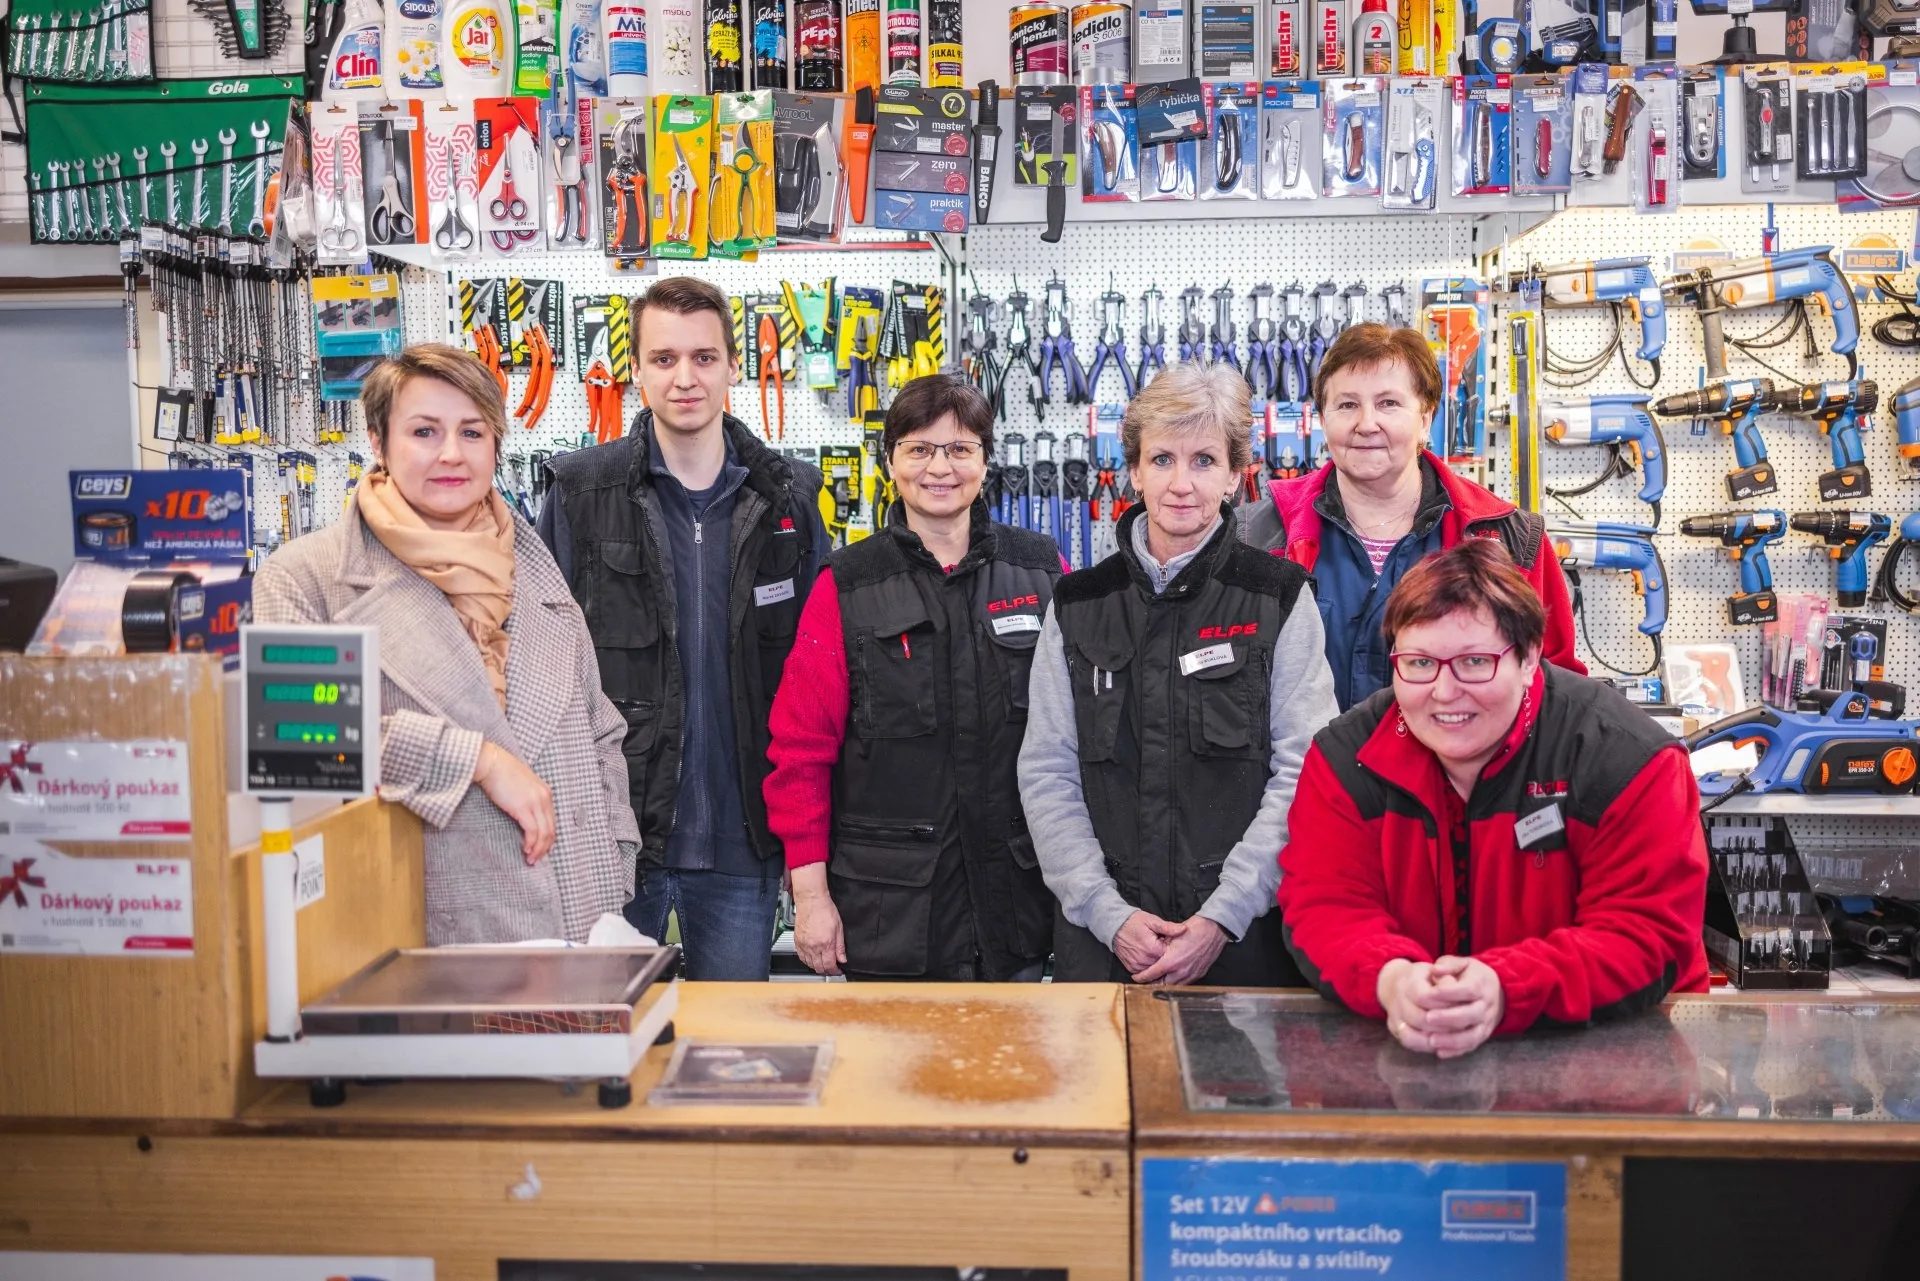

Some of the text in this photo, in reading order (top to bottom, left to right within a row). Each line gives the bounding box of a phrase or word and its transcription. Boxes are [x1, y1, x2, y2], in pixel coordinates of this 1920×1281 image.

[404, 3, 437, 14] SIDOLUX
[710, 6, 738, 25] Solvina
[756, 6, 784, 25] Solvina
[906, 18, 919, 26] DUST
[800, 26, 836, 41] PEPO
[1010, 20, 1046, 43] chnický
[1022, 27, 1057, 45] benzín
[1092, 28, 1122, 43] S 6006
[1371, 26, 1383, 39] 2
[931, 49, 955, 58] SILKAL
[336, 52, 378, 78] Clin
[1868, 71, 1884, 79] ANN
[208, 82, 249, 95] Gola
[949, 99, 955, 108] 7
[1159, 93, 1200, 108] rybička
[931, 121, 966, 132] master
[482, 123, 490, 148] orion
[931, 160, 957, 170] zero
[978, 166, 990, 209] BAHCO
[930, 199, 963, 210] praktik
[1846, 253, 1898, 268] narex
[499, 309, 506, 319] NA
[548, 311, 556, 321] NA
[577, 315, 585, 338] PLECH
[500, 323, 508, 346] PLECH
[548, 325, 556, 348] PLECH
[579, 341, 586, 352] NA
[749, 338, 756, 349] NA
[822, 457, 859, 465] STANLEY
[81, 477, 124, 494] ceys
[145, 489, 208, 520] x10
[165, 539, 212, 549] AMERICKÁ
[214, 539, 245, 549] PÁSKA
[987, 595, 1039, 612] ELPE
[1199, 622, 1259, 639] ELPE
[1195, 650, 1214, 658] ELPE
[1848, 760, 1875, 768] narex
[38, 779, 180, 799] Dárkový poukaz
[1527, 781, 1568, 795] ELPE
[1525, 815, 1542, 826] ELPE
[41, 893, 183, 914] Dárkový poukaz
[1170, 1196, 1205, 1214] Set
[1211, 1196, 1250, 1214] 12V
[1170, 1220, 1401, 1245] kompaktního vrtacího
[1442, 1230, 1536, 1241] Professional Tools
[1170, 1246, 1392, 1273] šroubováku a svítilny
